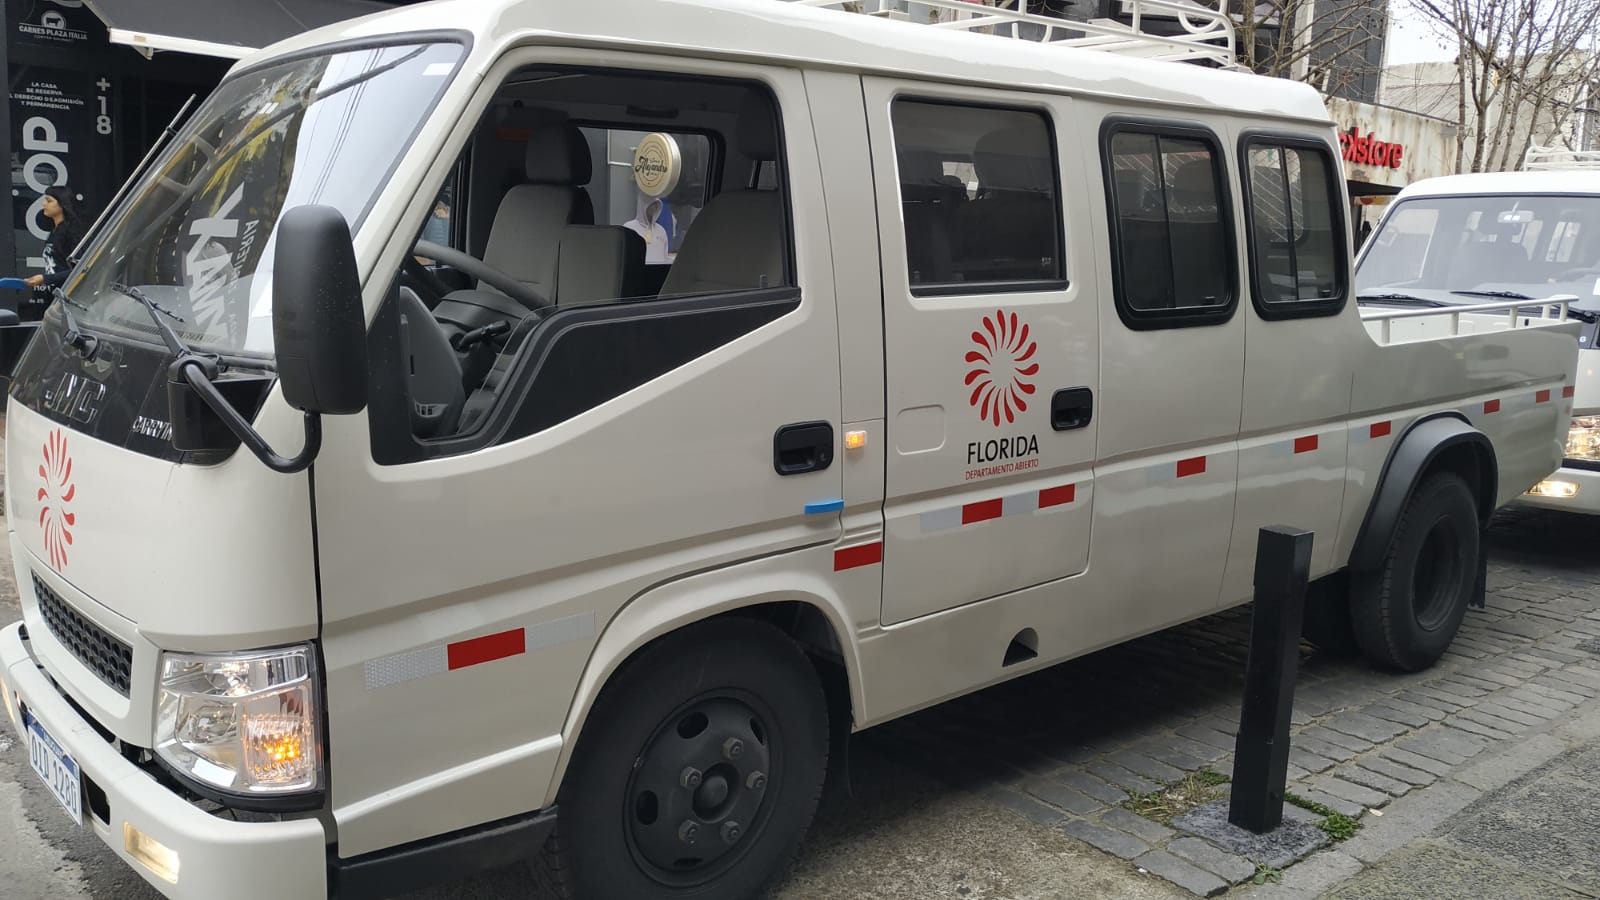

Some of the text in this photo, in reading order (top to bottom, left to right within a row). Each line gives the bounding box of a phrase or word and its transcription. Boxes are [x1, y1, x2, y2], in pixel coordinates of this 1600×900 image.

[18, 25, 45, 35] CARNES
[46, 28, 68, 37] PLAZA
[68, 31, 88, 40] ITALIA
[35, 88, 63, 96] RESERVA
[45, 371, 107, 424] JMC
[967, 433, 1039, 465] FLORIDA
[965, 458, 1039, 481] DEPARTAMENTO ABIERTO
